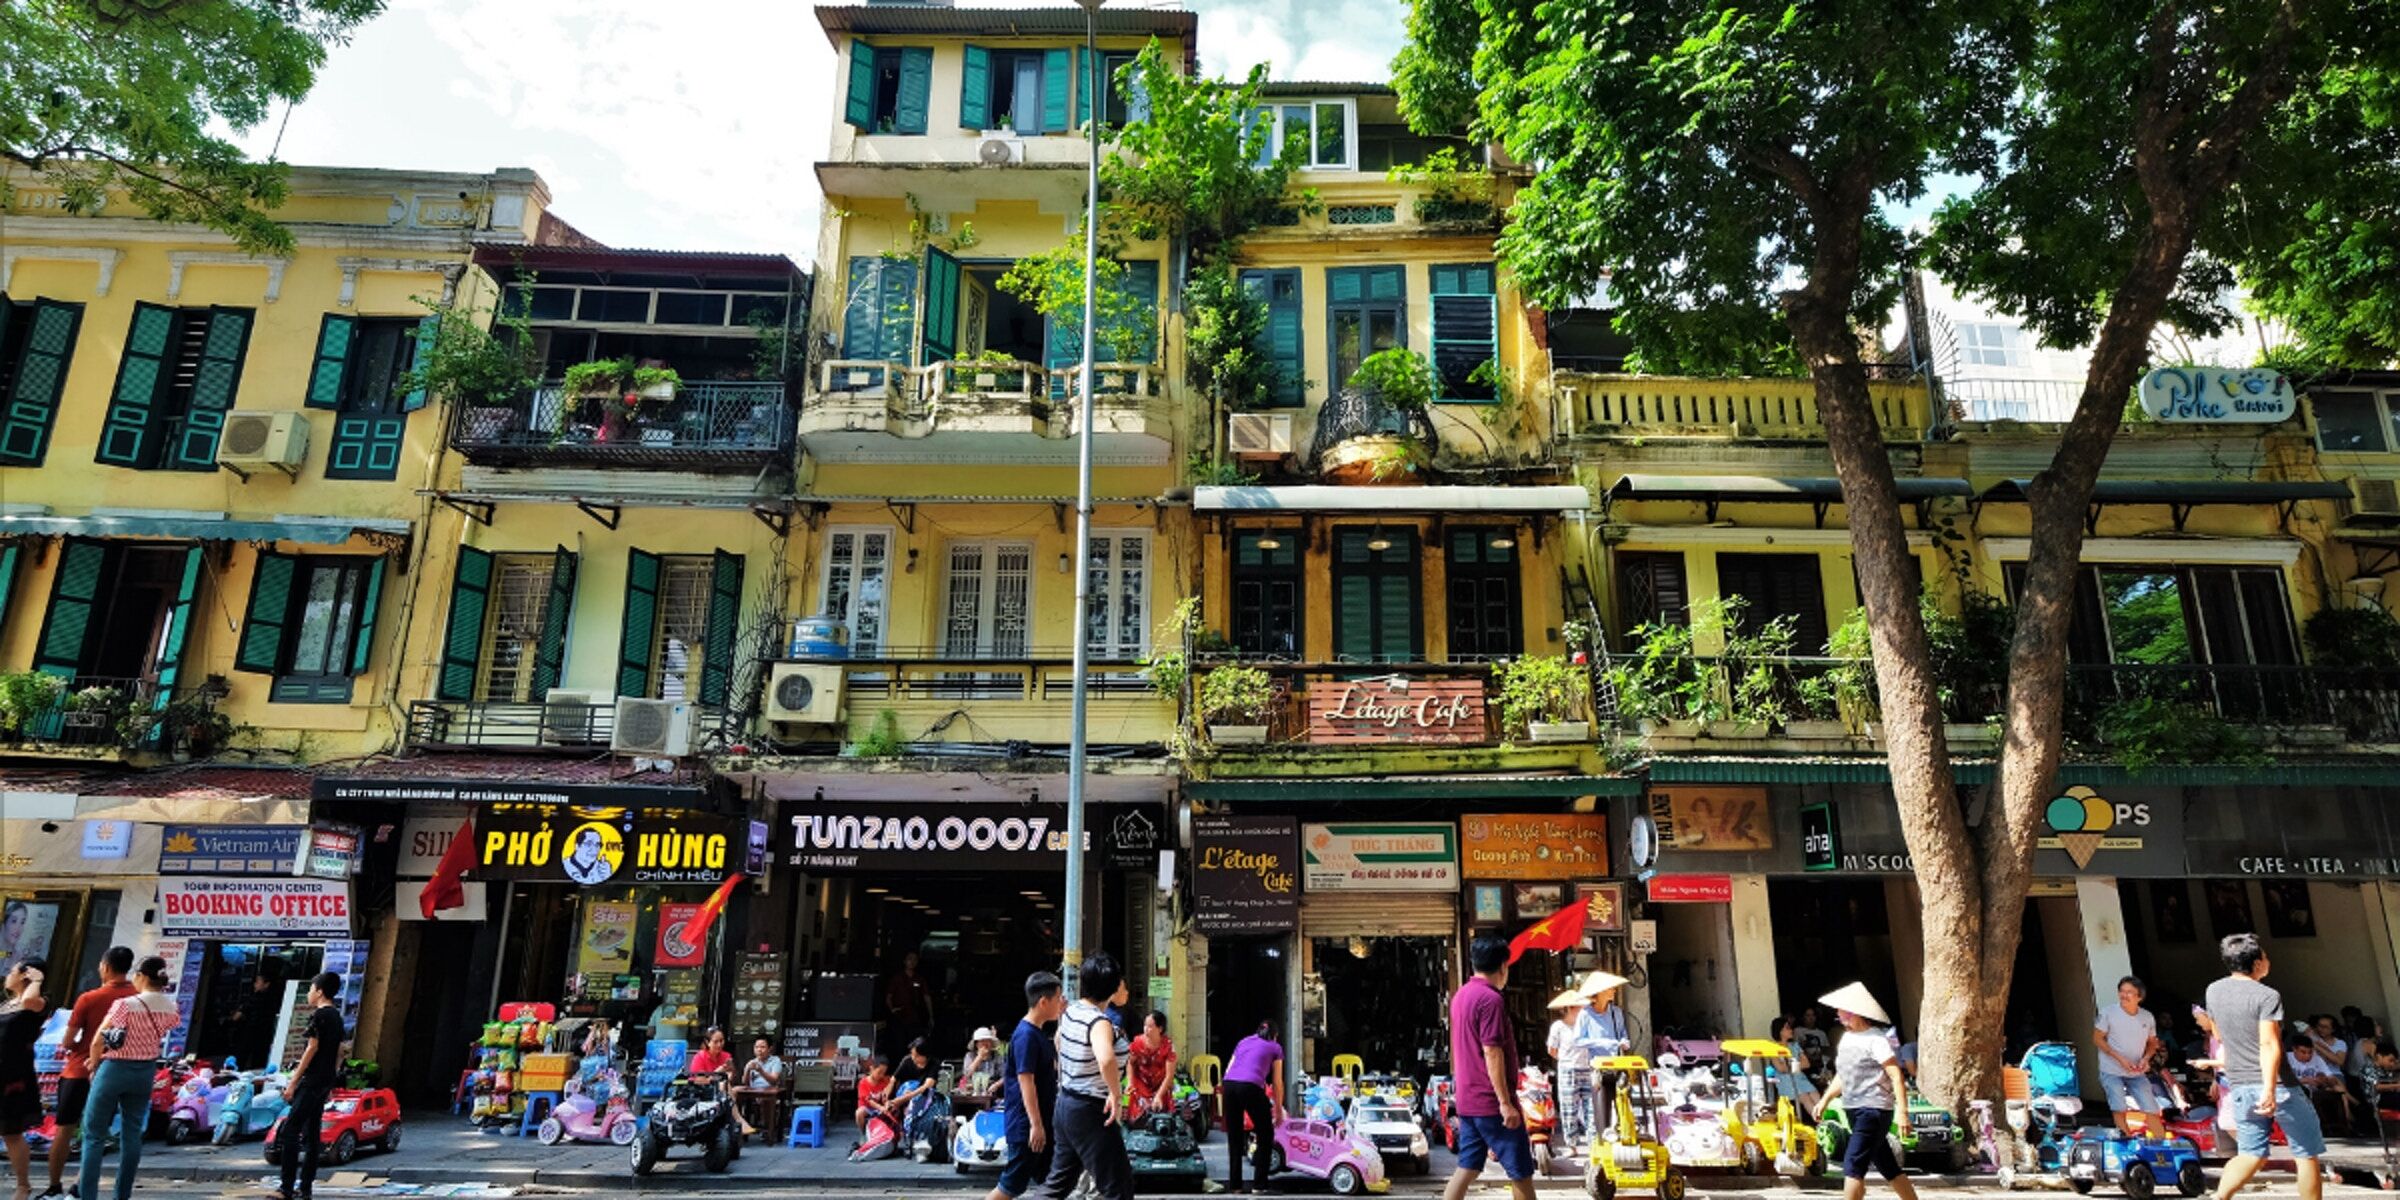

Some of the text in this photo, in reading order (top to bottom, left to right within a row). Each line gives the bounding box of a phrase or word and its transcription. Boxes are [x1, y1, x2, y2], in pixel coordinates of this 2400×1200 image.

[202, 836, 270, 853] Vietnam
[483, 821, 554, 866] PHỞ
[637, 827, 727, 869] HÙNG
[1047, 830, 1091, 851] CAE
[1805, 825, 1830, 853] aha
[2239, 857, 2286, 874] CAFE
[213, 883, 283, 892] INFORMATION
[286, 883, 323, 893] CENTER
[165, 893, 347, 917] BOOKING OFFICE
